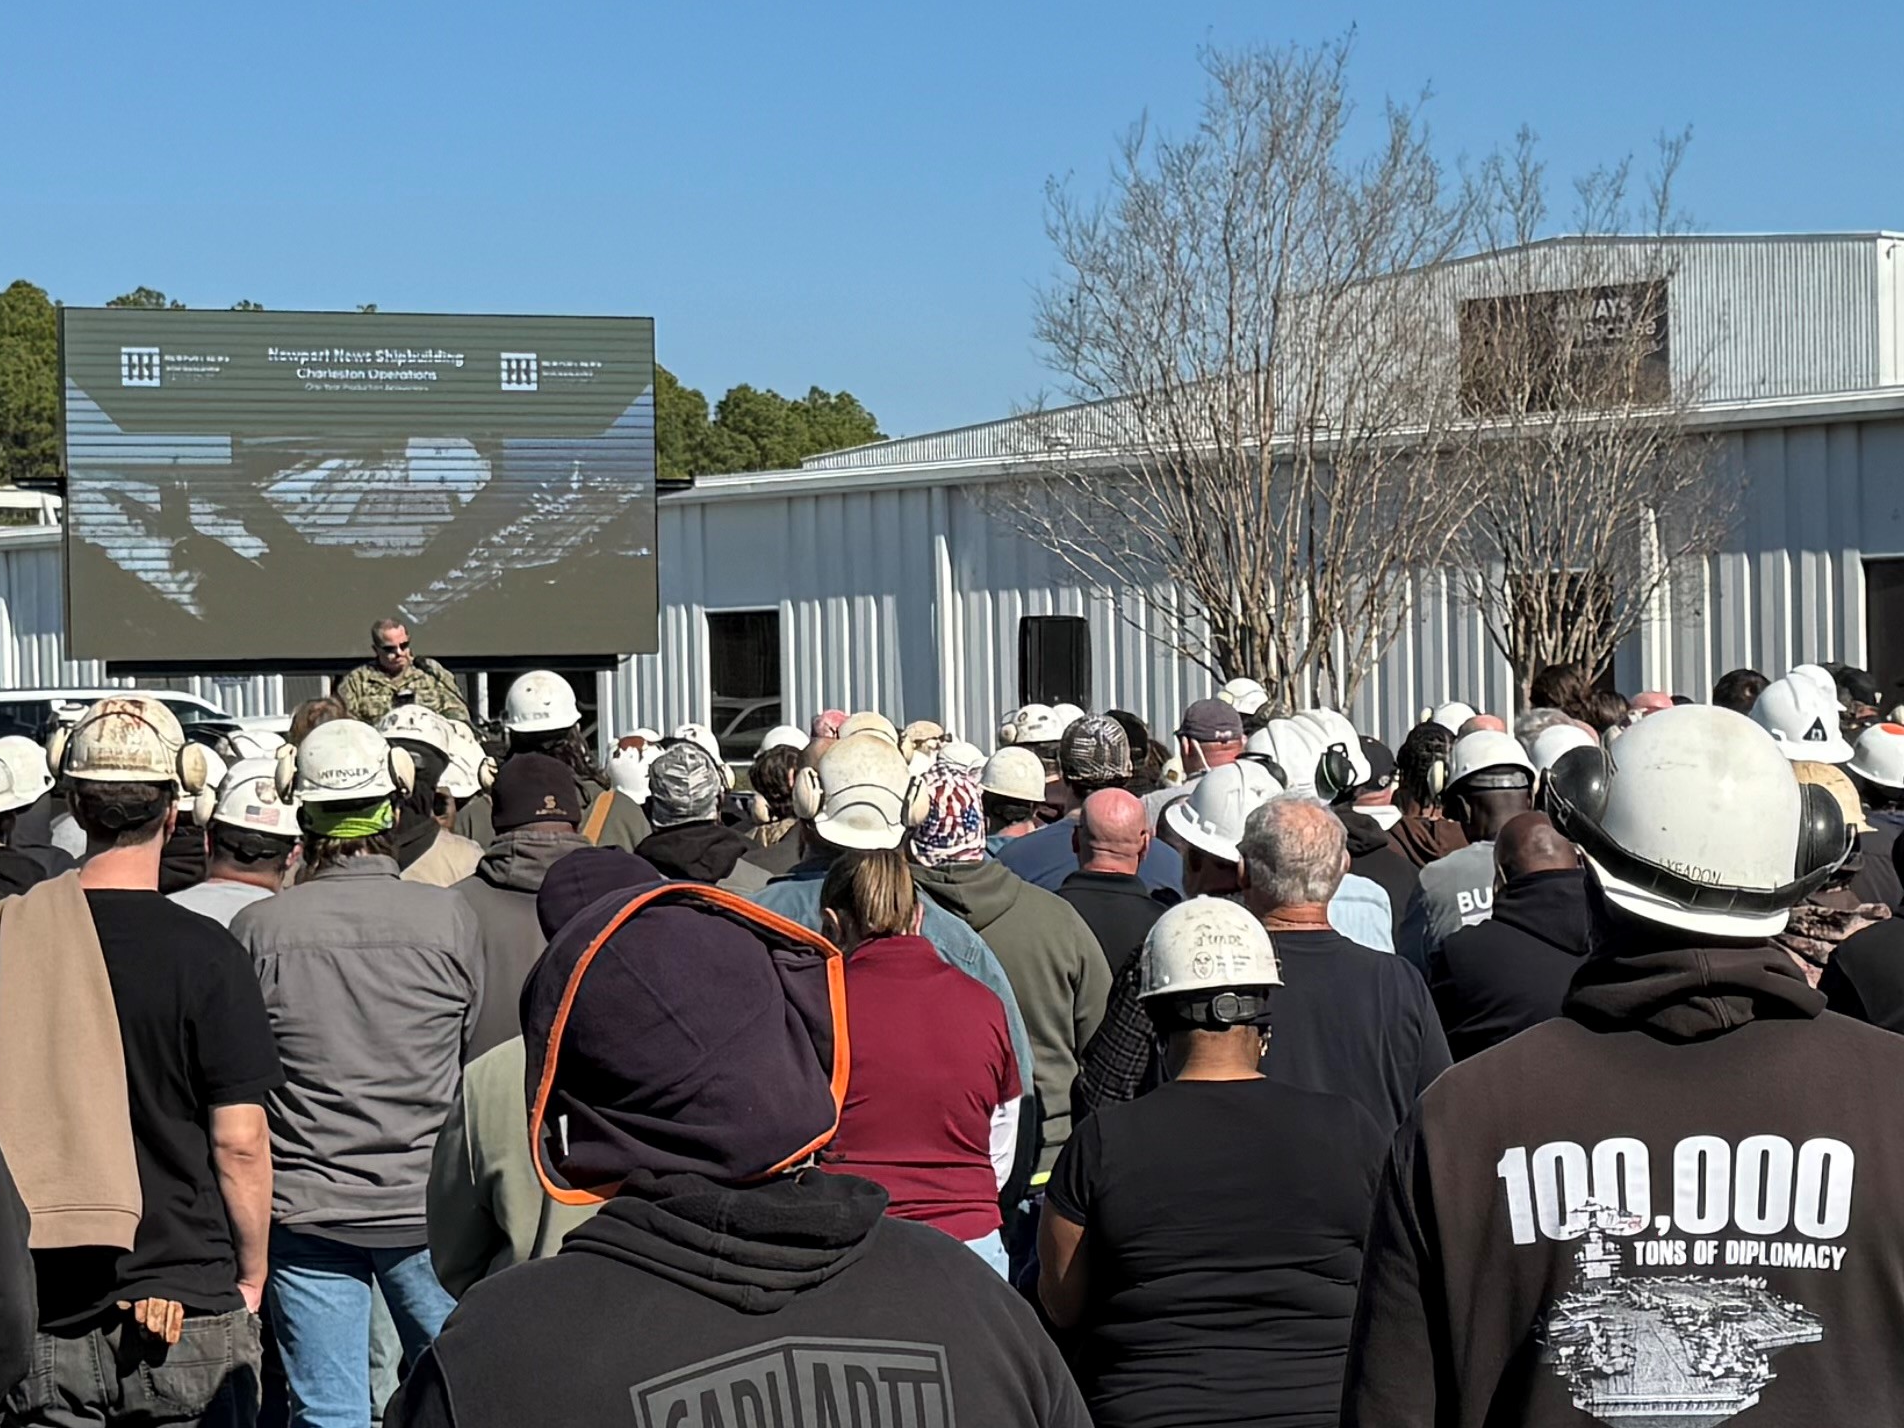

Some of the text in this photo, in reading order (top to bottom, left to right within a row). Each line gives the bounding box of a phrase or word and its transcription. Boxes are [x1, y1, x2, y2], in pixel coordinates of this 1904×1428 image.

[268, 347, 465, 368] Newport News Shipbuilding
[296, 368, 438, 384] Charleston Operations
[1497, 1134, 1855, 1246] 100,000
[1634, 1240, 1847, 1271] TONS OF DIPLOMACY
